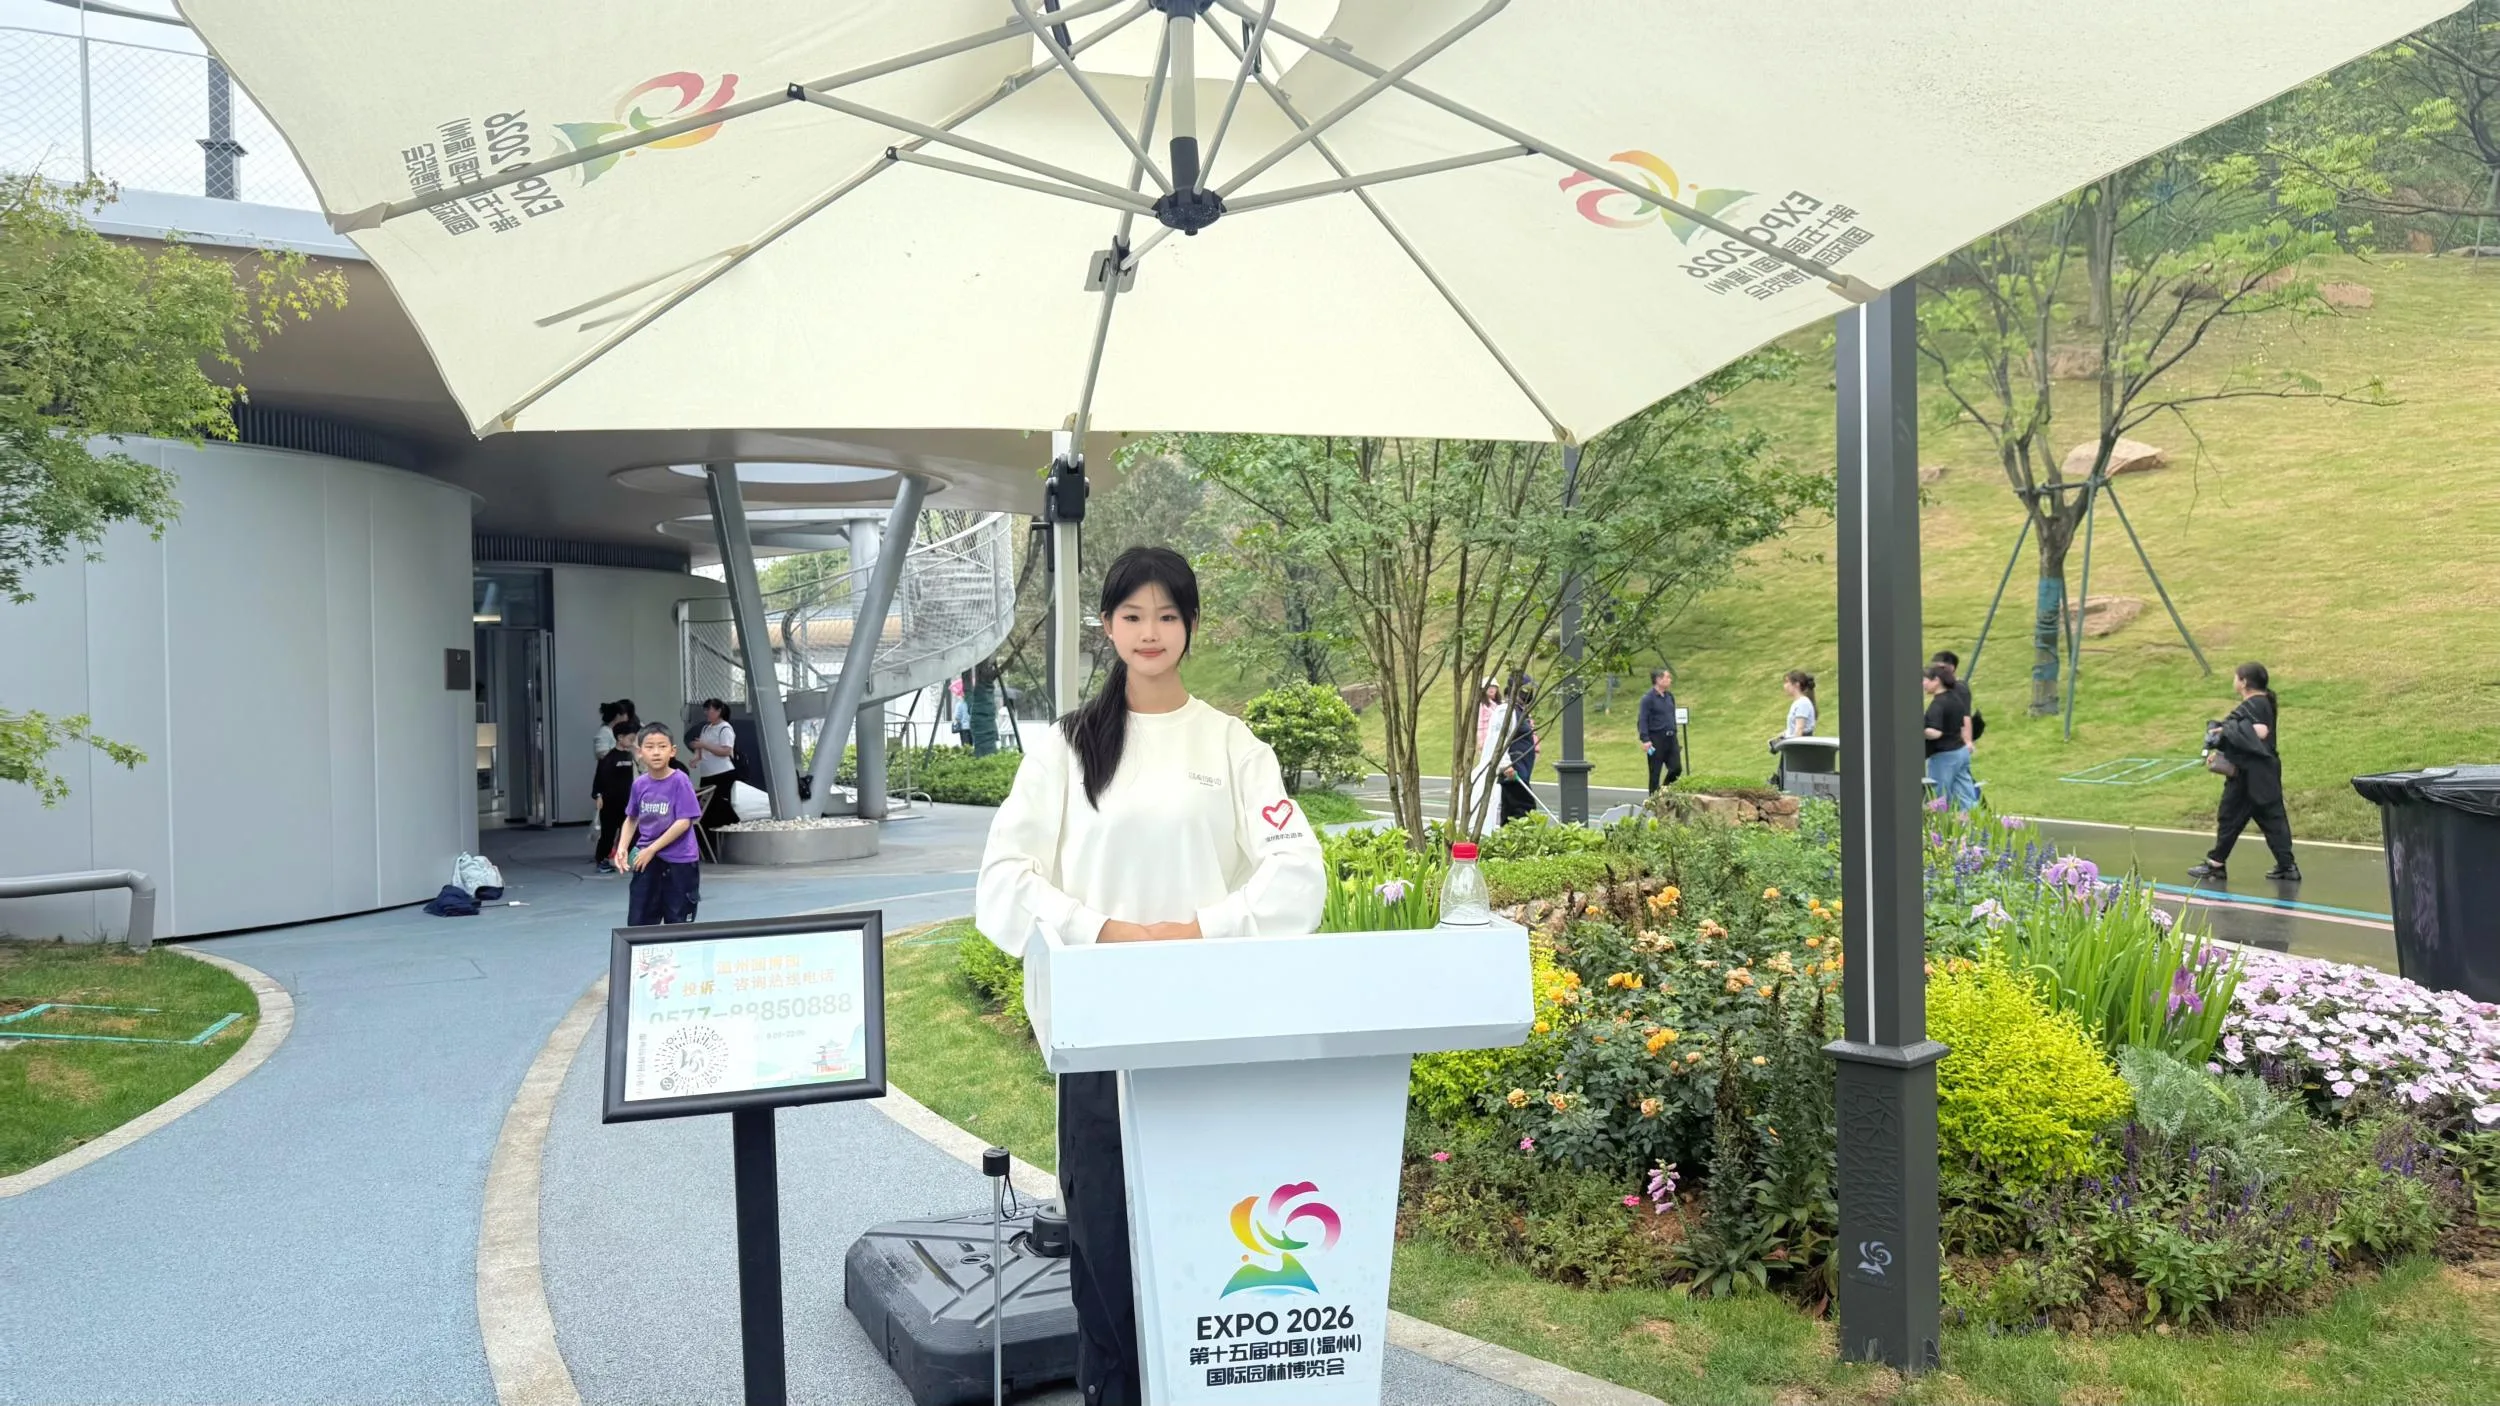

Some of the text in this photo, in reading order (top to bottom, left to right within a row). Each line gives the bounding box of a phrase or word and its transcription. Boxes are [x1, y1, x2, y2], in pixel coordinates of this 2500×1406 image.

[1197, 1305, 1354, 1340] EXPO 2026
[1190, 1334, 1361, 1365] 第十五届中国(温州)
[1206, 1358, 1345, 1386] 国际园林博览会
